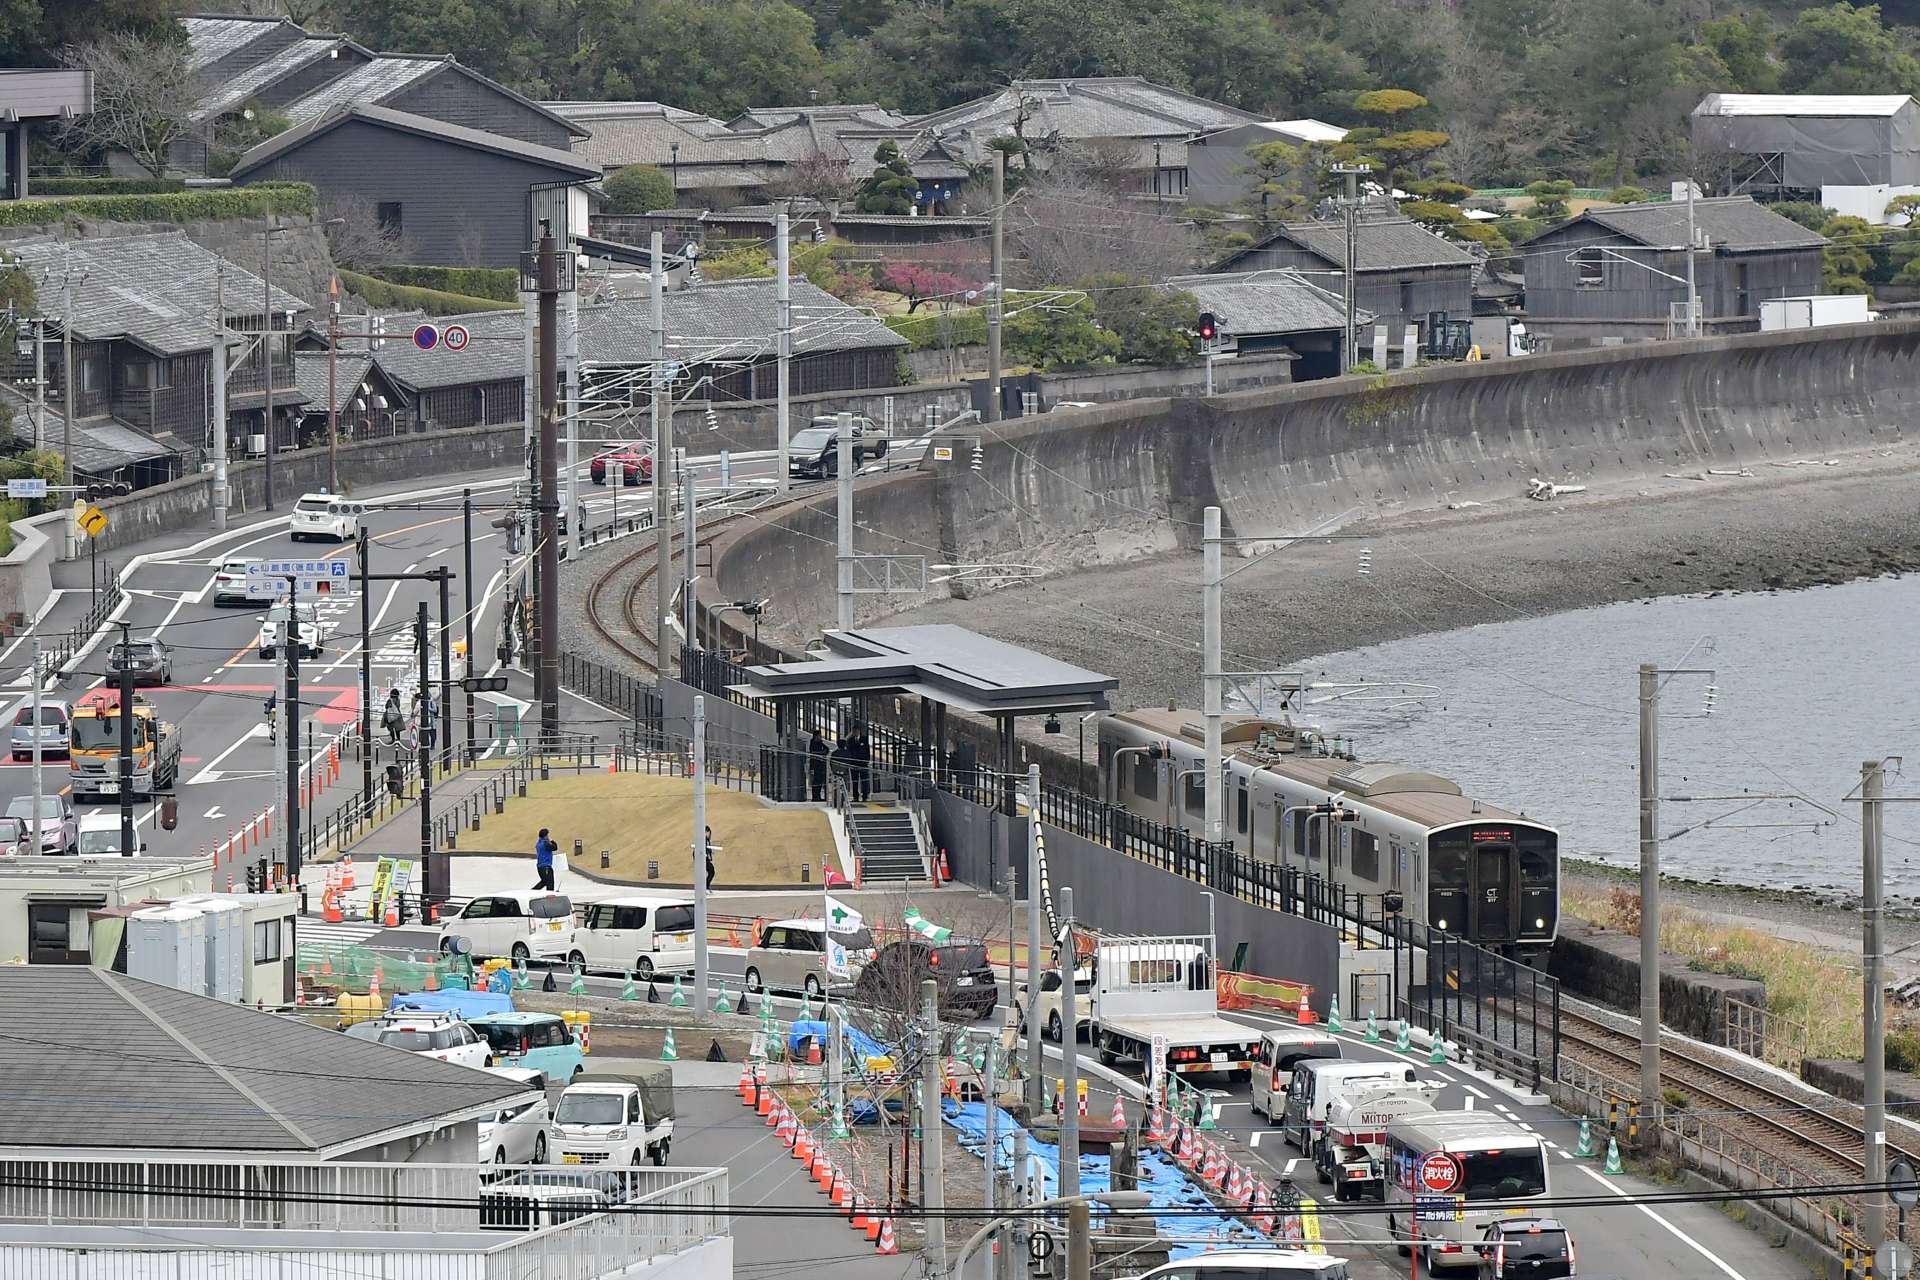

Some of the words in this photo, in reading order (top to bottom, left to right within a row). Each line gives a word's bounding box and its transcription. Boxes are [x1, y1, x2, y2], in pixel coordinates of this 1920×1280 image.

[449, 332, 462, 343] 40
[1424, 1166, 1453, 1180] 消火栓
